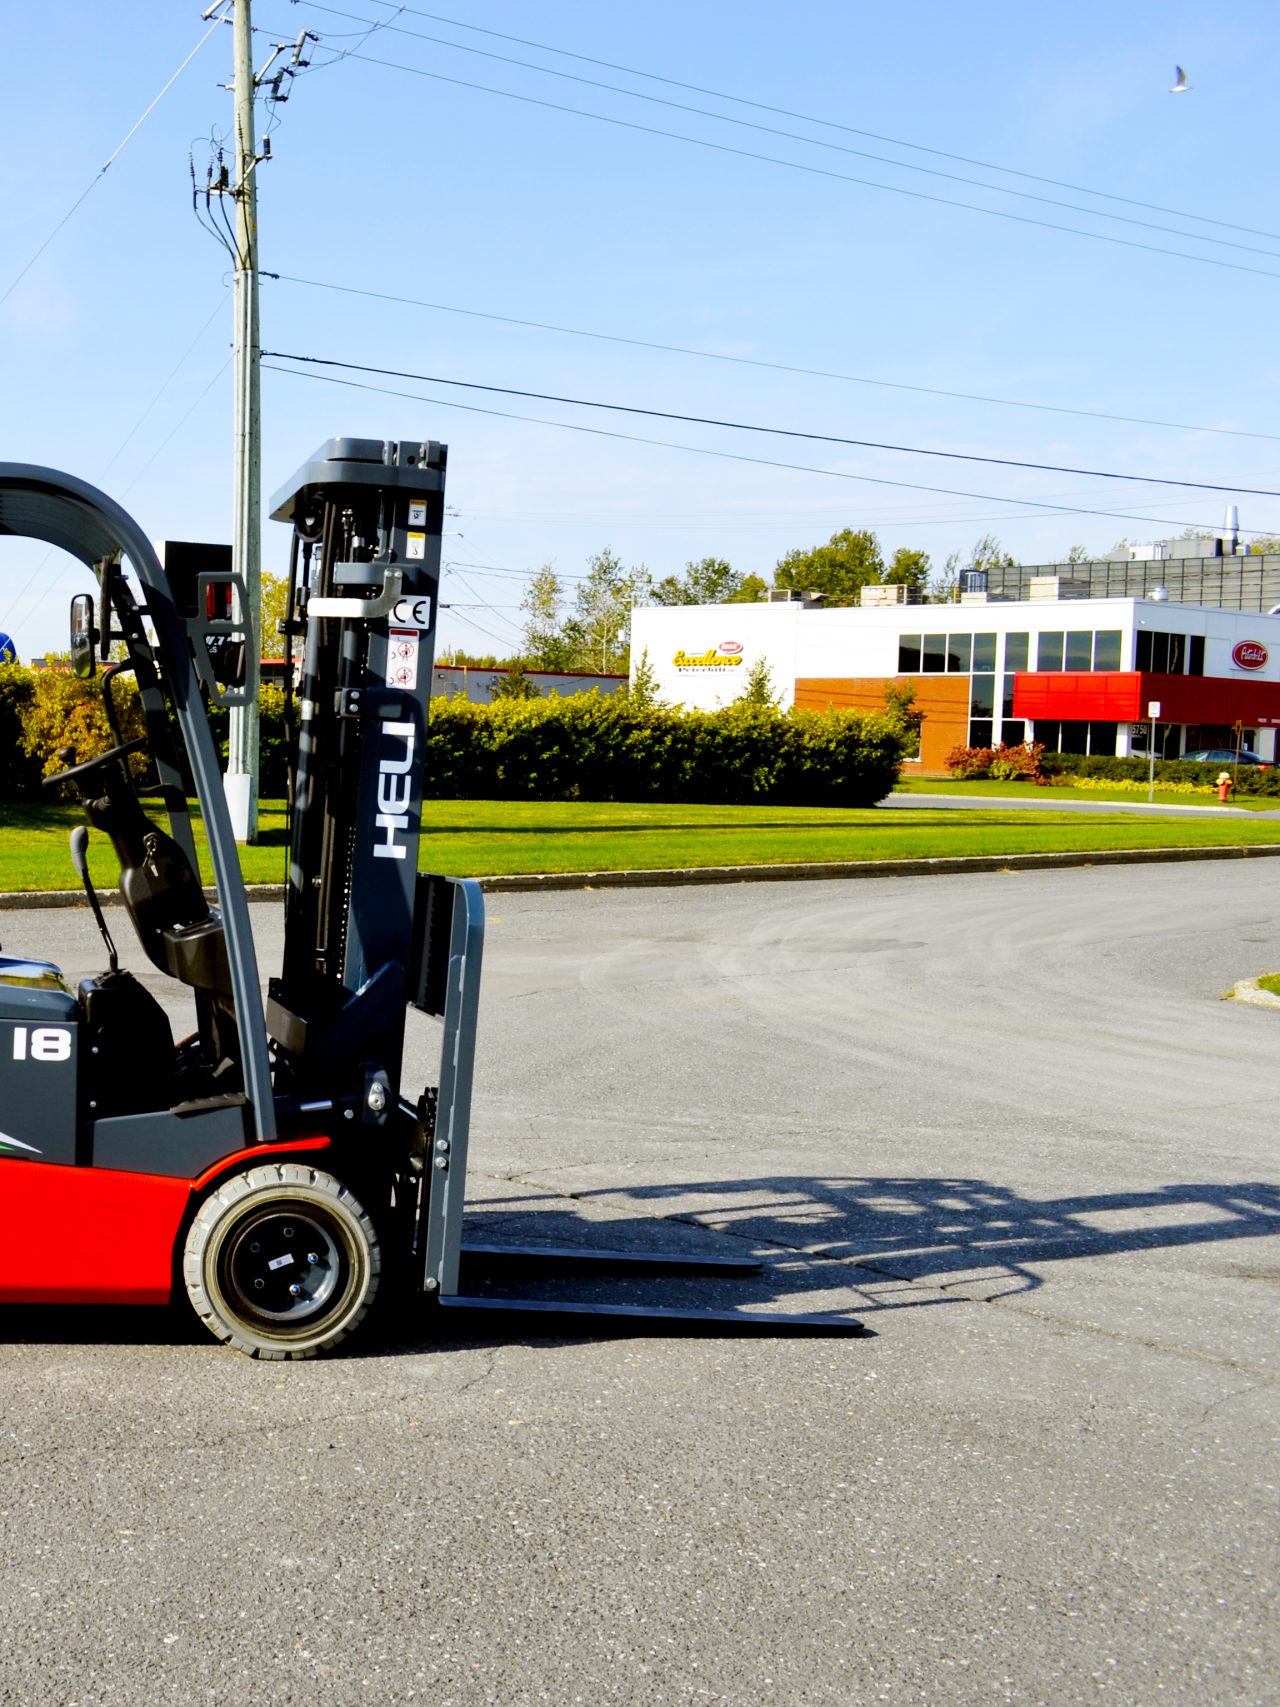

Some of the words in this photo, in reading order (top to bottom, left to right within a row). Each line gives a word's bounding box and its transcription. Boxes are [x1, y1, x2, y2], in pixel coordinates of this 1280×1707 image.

[393, 599, 427, 625] CE
[672, 649, 742, 667] Excellence
[373, 721, 416, 859] HELI
[13, 1027, 72, 1062] 18
